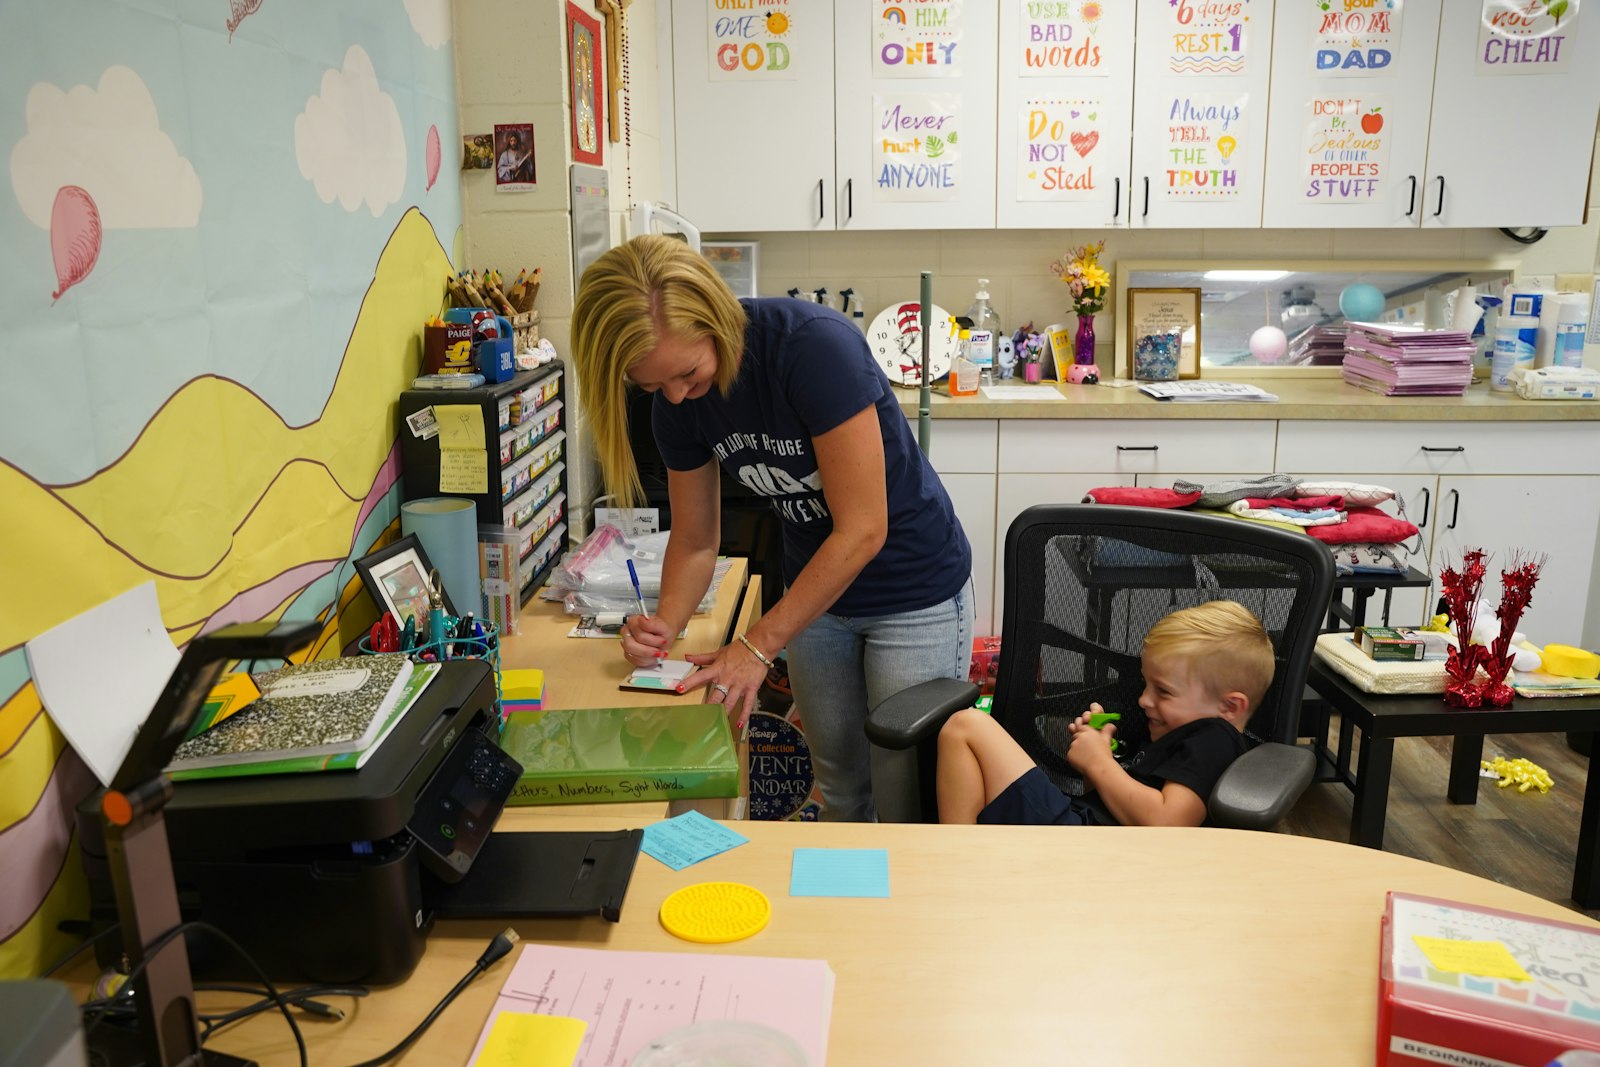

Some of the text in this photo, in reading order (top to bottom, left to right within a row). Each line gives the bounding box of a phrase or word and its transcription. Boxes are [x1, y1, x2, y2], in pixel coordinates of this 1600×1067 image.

[1027, 2, 1070, 19] USE
[1177, 0, 1242, 25] 6 days
[1344, 0, 1374, 12] your
[1492, 0, 1541, 27] not
[916, 8, 947, 27] HIM
[1319, 12, 1391, 34] MOM
[715, 15, 761, 39] ONE
[1030, 24, 1072, 42] BAD
[1173, 24, 1242, 53] REST 1
[1351, 35, 1362, 48] &
[717, 42, 790, 71] GOD
[881, 42, 957, 65] ONLY
[1025, 37, 1101, 68] words
[1484, 36, 1565, 64] CHEAT
[1316, 49, 1392, 70] DAD
[1169, 98, 1240, 131] Always
[1313, 99, 1362, 116] DON'T
[881, 104, 954, 132] Never
[1028, 110, 1064, 141] Do
[1331, 117, 1346, 129] Be
[1169, 126, 1211, 143] TELL
[1308, 132, 1382, 154] Jealous
[882, 138, 921, 153] hurt
[1028, 144, 1068, 162] NOT
[1169, 148, 1207, 164] THE
[1324, 150, 1368, 161] OF OTHER
[877, 163, 954, 189] ANYONE
[1042, 166, 1096, 190] Steal
[1166, 169, 1237, 187] TRUTH
[1310, 163, 1379, 176] PEOPLE'S
[1306, 179, 1379, 197] STUFF
[887, 318, 896, 326] 11
[940, 321, 946, 329] 2
[447, 328, 472, 338] PAIGE
[877, 332, 888, 340] 10
[945, 337, 952, 345] 3
[879, 347, 886, 355] 9
[887, 360, 893, 368] 8
[934, 364, 940, 372] 5
[757, 744, 795, 753] Collection
[749, 755, 808, 776] VENT
[510, 778, 684, 798] etters, Numbers, Sight Words
[751, 779, 807, 796] NDAR
